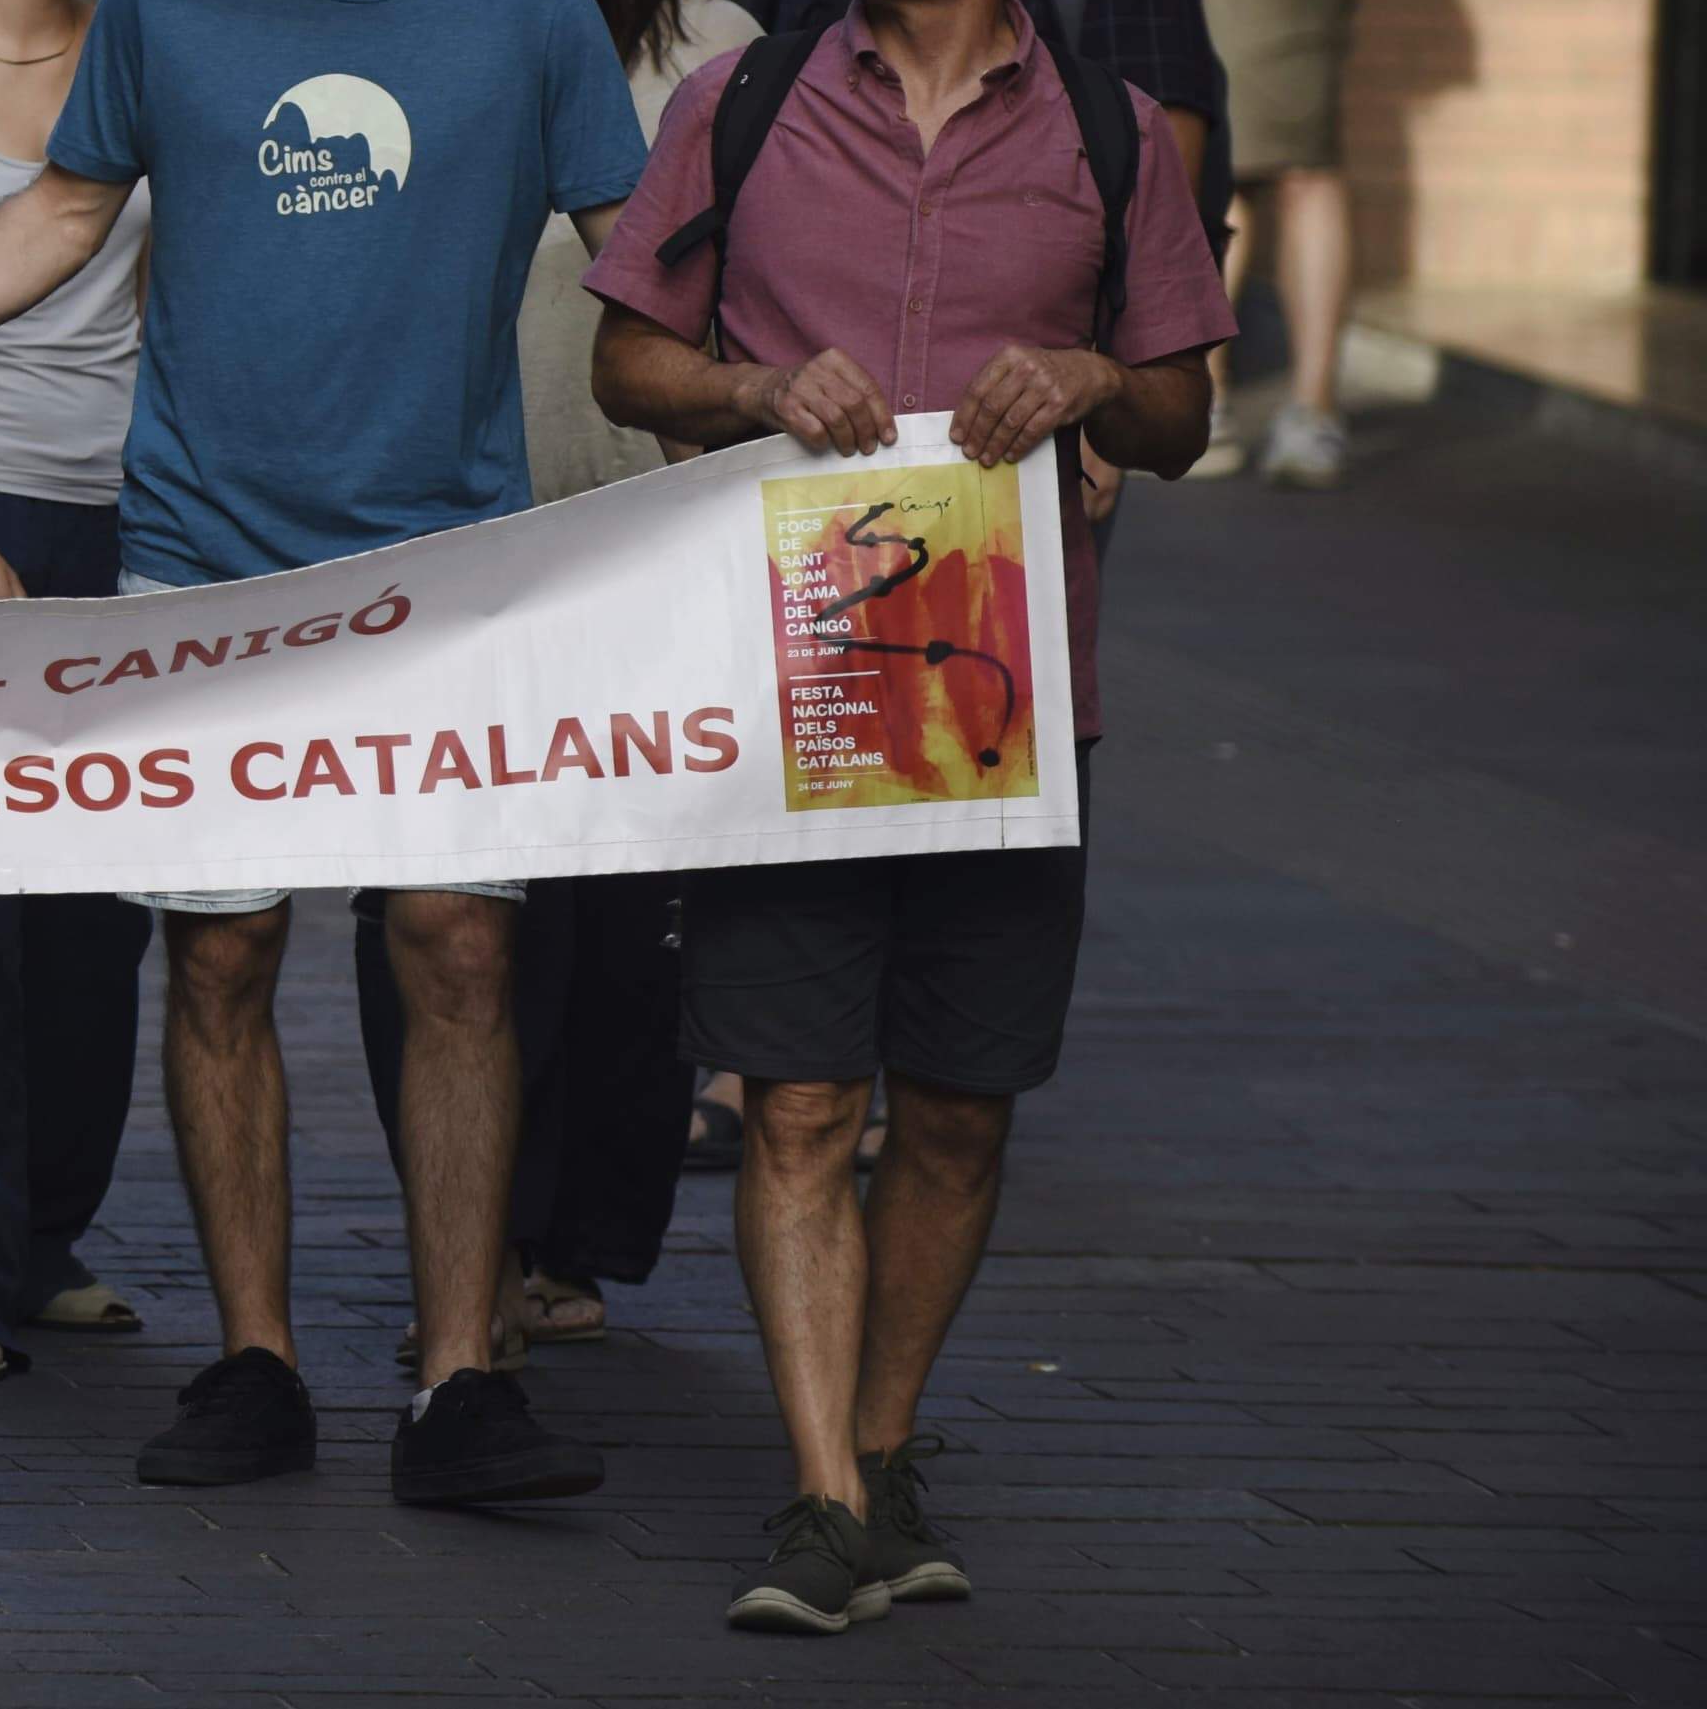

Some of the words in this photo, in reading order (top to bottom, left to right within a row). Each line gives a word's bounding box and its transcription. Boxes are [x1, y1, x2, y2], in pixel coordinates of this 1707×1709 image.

[258, 140, 334, 176] Cims
[310, 171, 352, 187] contra
[356, 167, 366, 182] el
[277, 184, 379, 215] càncer
[777, 518, 823, 534] FOCS
[779, 539, 802, 552] DE
[780, 552, 824, 568] SANT
[782, 570, 827, 586] JOAN
[783, 585, 840, 603] FLAMA
[784, 605, 817, 620] DEL
[786, 618, 852, 636] CANIGÓ
[43, 582, 413, 696] CANIGÓ
[787, 649, 799, 658] 23
[801, 648, 816, 657] DE
[818, 646, 845, 656] JUNY
[791, 686, 844, 701] FESTA
[793, 700, 878, 718] NACIONAL
[794, 720, 837, 736] DELS
[795, 735, 856, 752] PAÏSOS
[230, 706, 741, 802] CATALANS
[797, 752, 884, 770] CATALANS
[798, 782, 809, 792] 24
[811, 782, 823, 790] DE
[825, 780, 855, 790] JUNY
